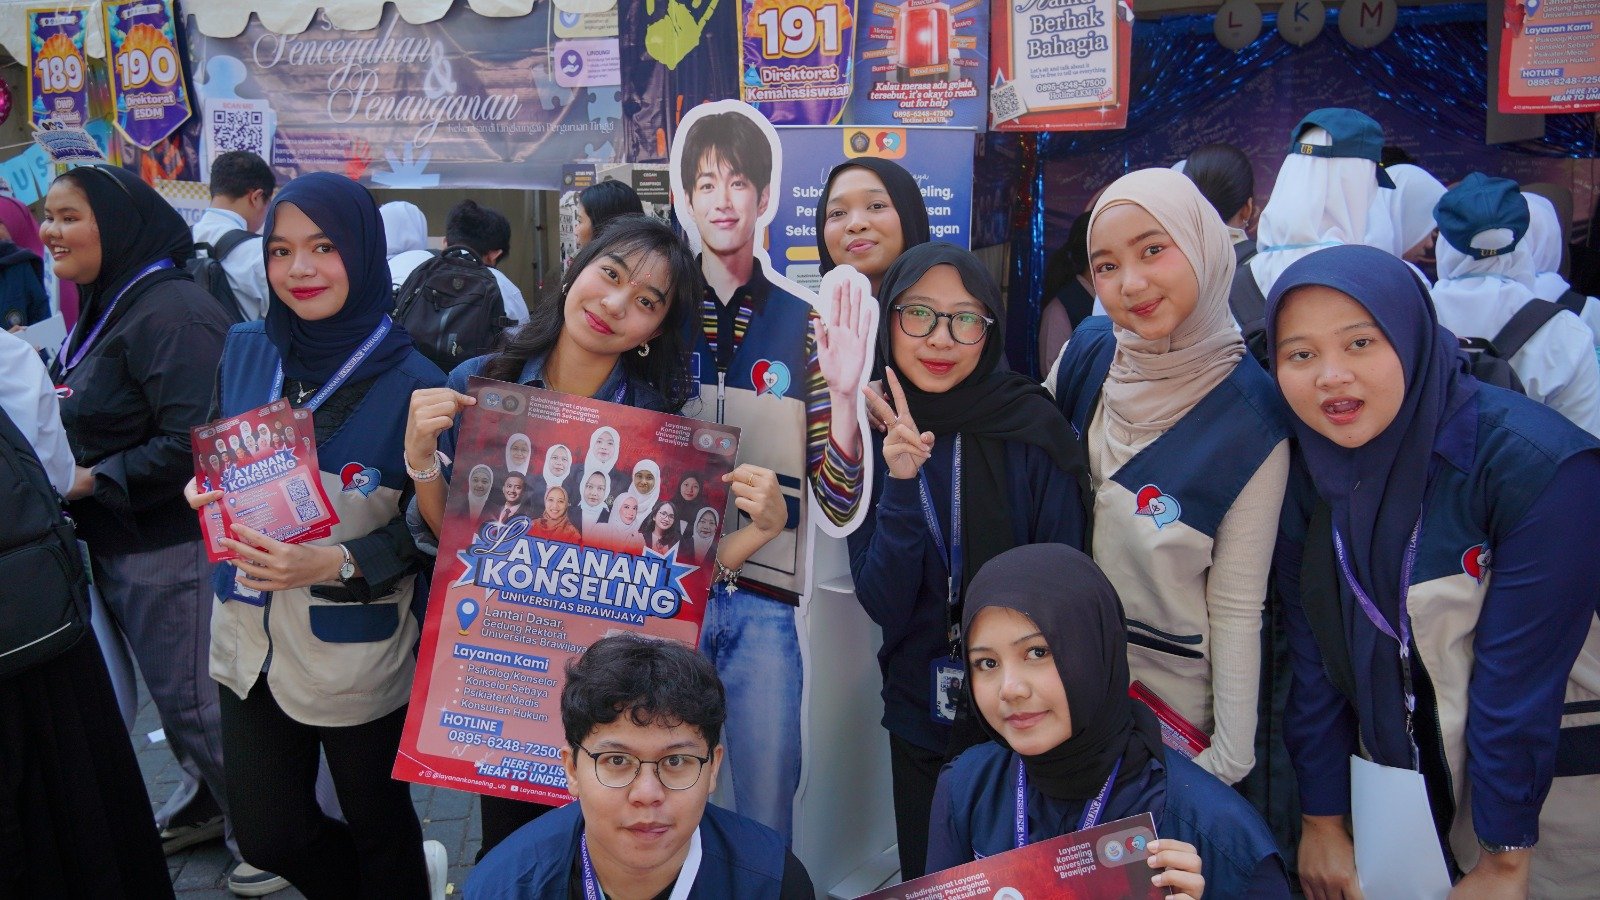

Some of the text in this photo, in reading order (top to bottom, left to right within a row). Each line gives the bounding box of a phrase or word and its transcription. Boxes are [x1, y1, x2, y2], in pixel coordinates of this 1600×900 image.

[1030, 5, 1104, 35] Berhak
[1525, 22, 1593, 36] Layanan Kami
[758, 5, 838, 55] 191
[1027, 31, 1109, 59] Bahagia
[117, 46, 179, 89] 190
[253, 30, 431, 92] Pencegahan
[37, 55, 84, 92] 189
[762, 66, 837, 84] Direktorat
[1522, 68, 1560, 78] HOTLINE
[1527, 76, 1600, 87] 0895-6248-725
[746, 84, 850, 101] Kemahasiswaan
[870, 87, 978, 100] tersebut, it's okay to reach
[875, 79, 973, 91] Kalau merasa ada gejala
[1587, 86, 1599, 94] TO
[126, 91, 176, 107] Direktorat
[900, 99, 949, 109] out for help
[1550, 94, 1573, 102] HEAR
[1573, 93, 1585, 101] TO
[327, 67, 522, 148] Penanganan
[1300, 144, 1314, 155] UB
[921, 187, 954, 200] eling,
[785, 225, 817, 237] Seks
[530, 395, 599, 414] Subdirektorat Layanan
[561, 407, 600, 420] Pencegahan
[527, 411, 569, 425] Perundungan
[528, 406, 599, 425] Kekerasan Seksual dan
[665, 421, 692, 431] Layanan
[228, 459, 297, 492] KONSELING
[473, 518, 661, 588] LAYANAN
[481, 557, 676, 615] KONSELING
[501, 590, 645, 625] UNIVERSITAS BRAWIJAYA
[485, 605, 566, 631] Lantai Dasar,
[482, 618, 568, 640] Gedung Rektorat
[481, 628, 588, 655] Universitas Brawijaya
[453, 644, 550, 671] Layanan Kami
[467, 663, 558, 688] Psikolog/Konselor
[465, 675, 549, 698] Konselor Sebaya
[463, 687, 539, 708] Psikiater/Medis
[460, 698, 549, 722] Konsultan Hukum
[443, 712, 498, 733] HOTLINE
[478, 763, 569, 788] HEAR TO UNDER
[501, 757, 565, 776] HERE TO LIS
[432, 772, 507, 790] @layanankonseling_ub
[519, 786, 547, 796] Layanan
[1056, 849, 1093, 864] Konseling
[1058, 842, 1091, 855] Layanan
[1053, 856, 1095, 873] Universitas
[1060, 864, 1097, 879] Brawijaya
[905, 872, 985, 900] Subdirektorat Layanan
[945, 879, 989, 896] Pencegahan
[976, 886, 992, 895] dan
